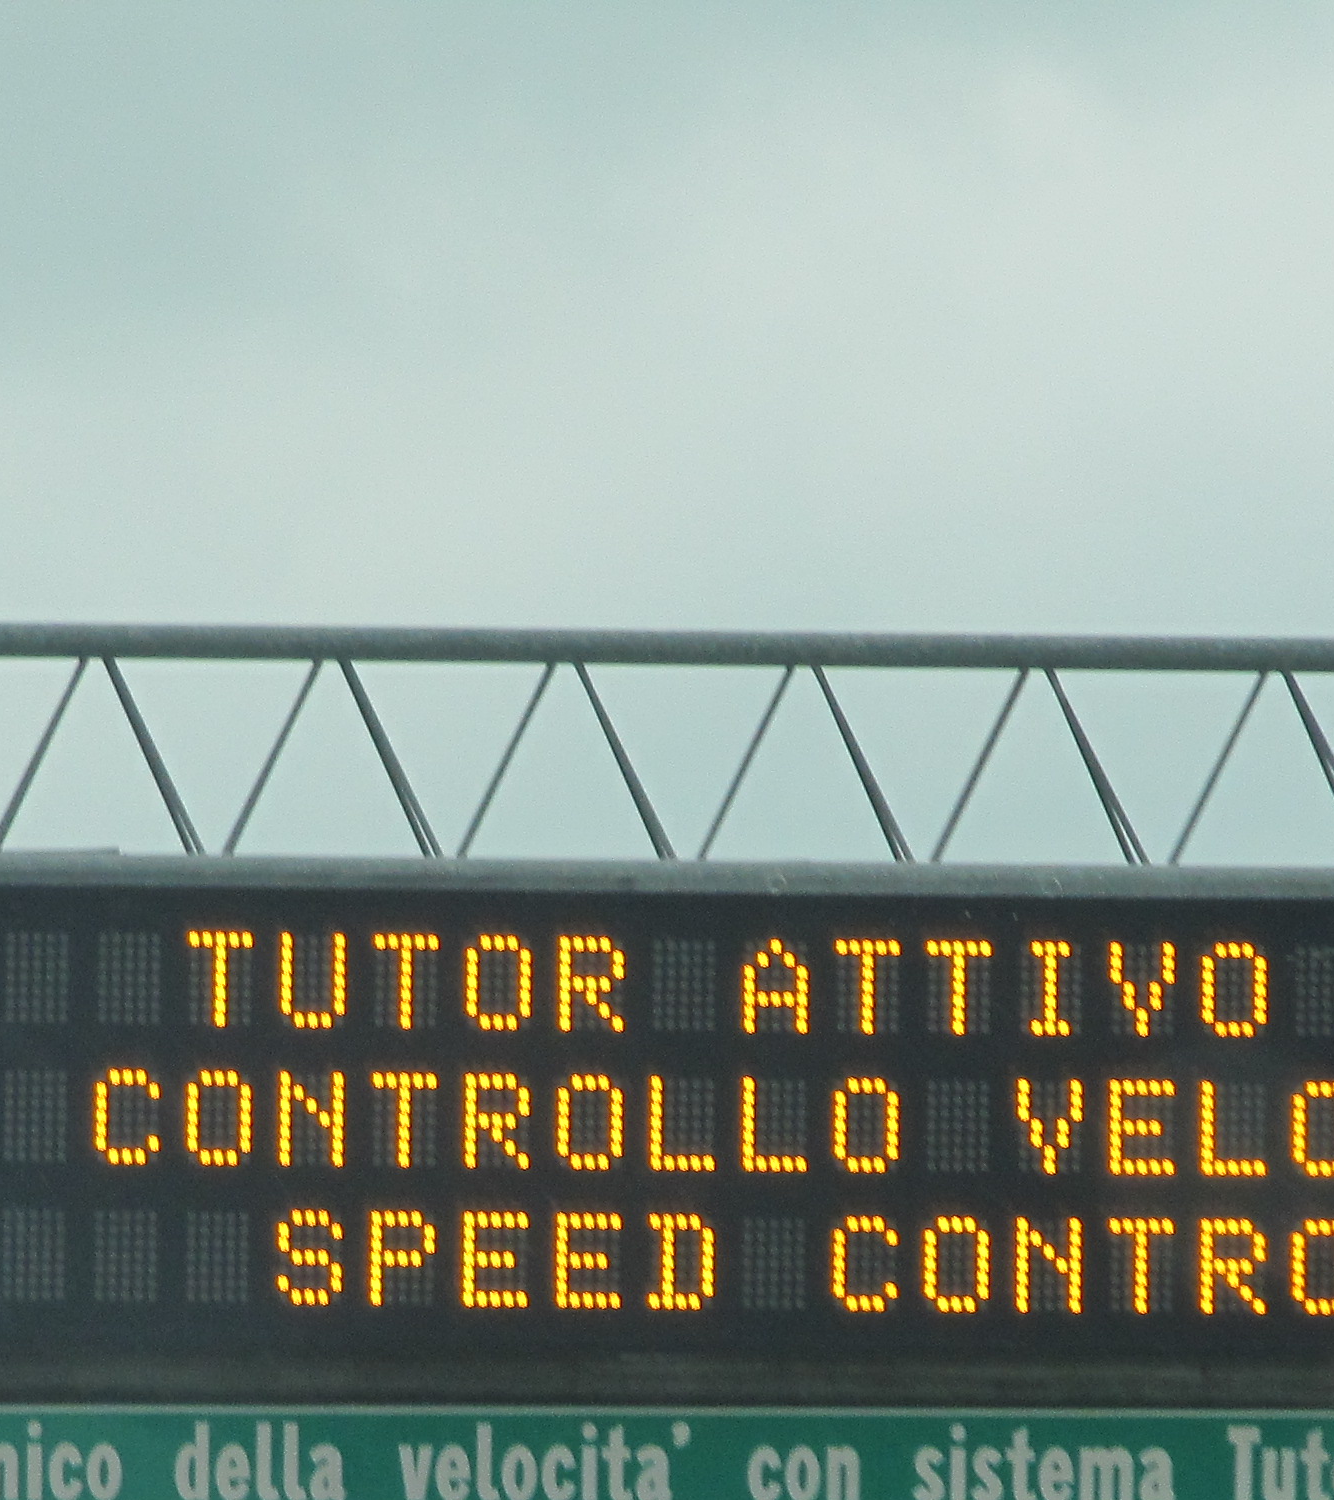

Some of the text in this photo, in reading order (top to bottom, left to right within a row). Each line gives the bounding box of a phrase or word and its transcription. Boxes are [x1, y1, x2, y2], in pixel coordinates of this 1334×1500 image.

[187, 930, 625, 1033] TUTOR
[742, 938, 1269, 1038] ATTIVO
[93, 1067, 900, 1174] CONTROLLO
[276, 1208, 715, 1311] SPEED
